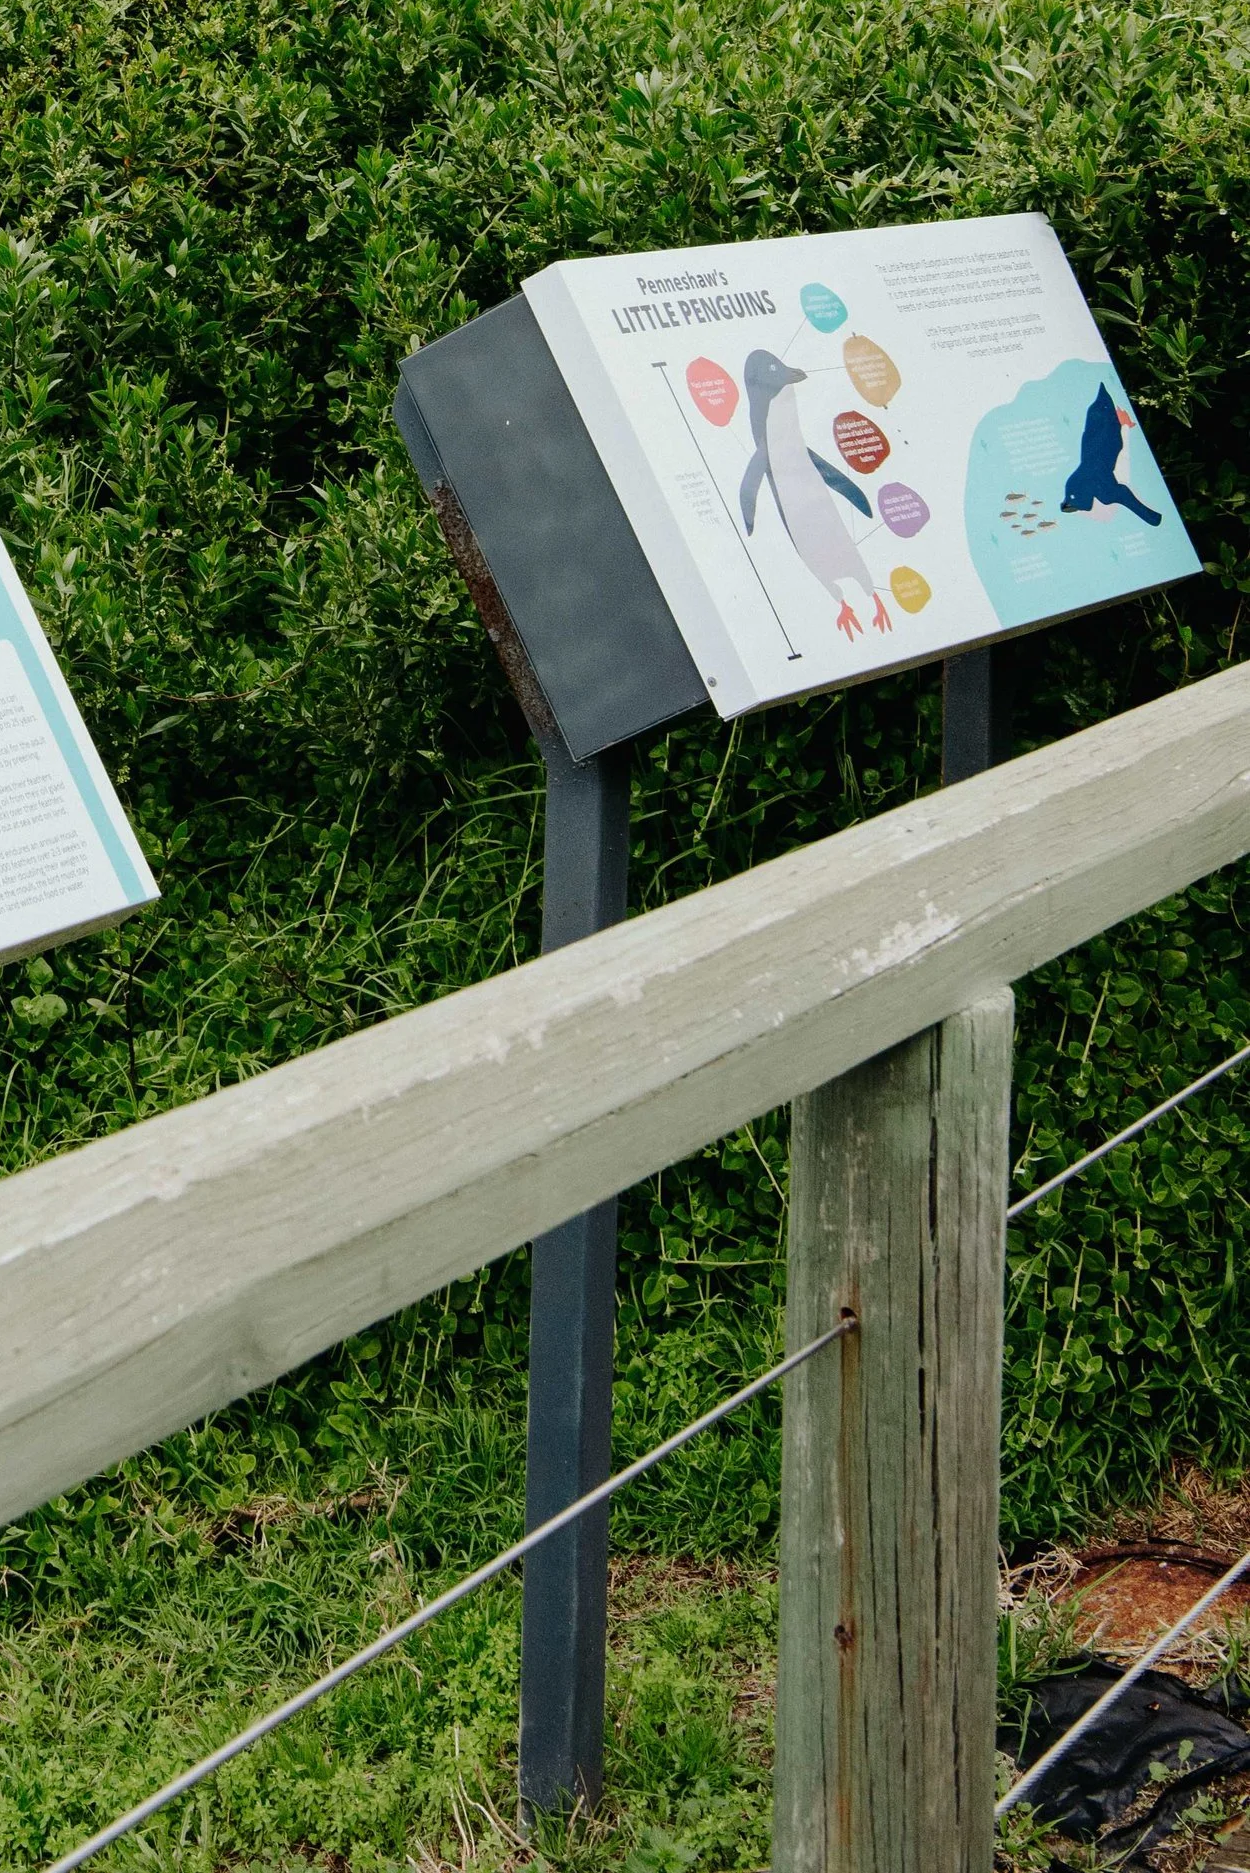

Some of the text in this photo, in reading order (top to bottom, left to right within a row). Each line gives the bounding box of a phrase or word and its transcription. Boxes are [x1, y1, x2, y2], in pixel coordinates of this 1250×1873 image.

[635, 268, 729, 296] Penneshaw's
[611, 301, 680, 335] LITTLE
[677, 289, 777, 327] PENGUINS
